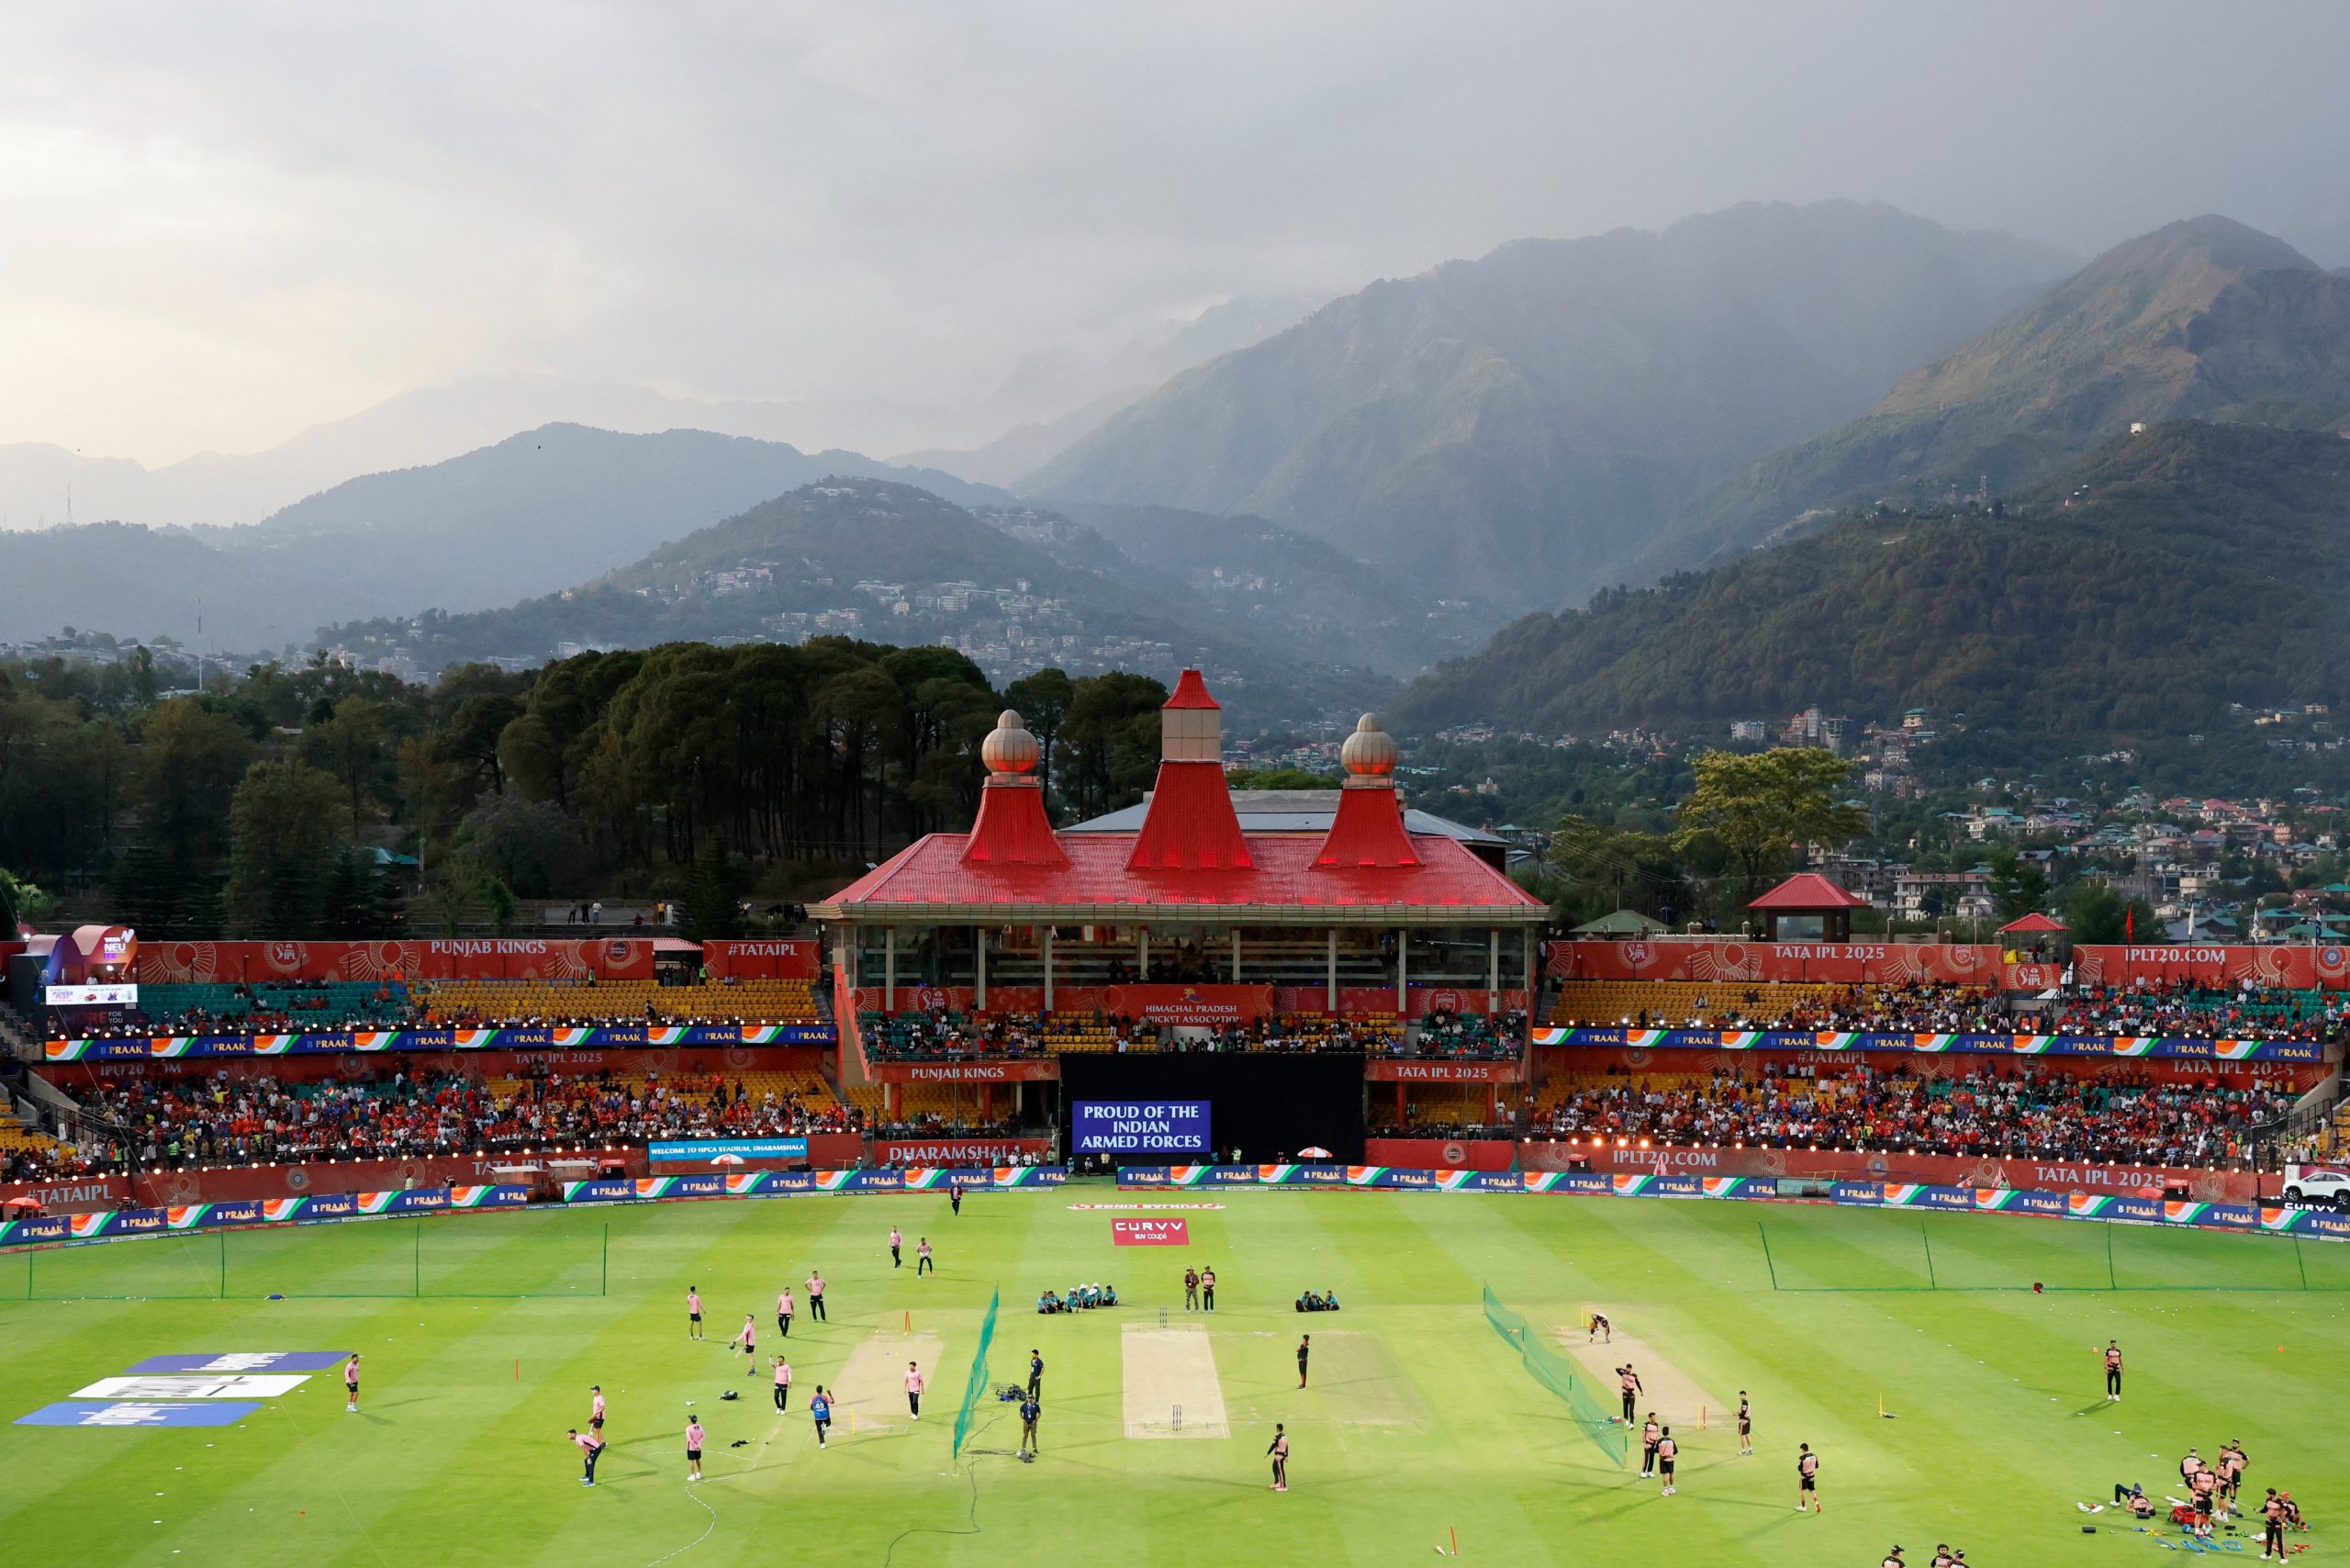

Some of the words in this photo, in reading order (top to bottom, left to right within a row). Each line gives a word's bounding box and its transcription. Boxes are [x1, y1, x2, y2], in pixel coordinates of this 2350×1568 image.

[104, 943, 126, 952] NEU
[431, 941, 492, 957] PUNJAB
[497, 941, 547, 954] KINGS
[728, 944, 798, 957] #TATAIPL
[1774, 946, 1811, 958] TATA
[1816, 946, 1840, 958] IPL
[1844, 946, 1885, 959] 2025
[2125, 948, 2225, 962] IPLT20.COM
[2028, 977, 2042, 986] IPL
[1147, 1015, 1181, 1024] RICKET
[514, 1034, 546, 1043] PRAAK
[610, 1033, 641, 1042] PRAAK
[705, 1032, 735, 1040] PRAAK
[799, 1031, 829, 1040] PRAAK
[1589, 1034, 1619, 1043] PRAAK
[1683, 1036, 1714, 1045] PRAAK
[316, 1039, 349, 1047] PRAAK
[415, 1036, 447, 1046] PRAAK
[1779, 1036, 1810, 1046] PRAAK
[1874, 1038, 1907, 1047] PRAAK
[1974, 1040, 2006, 1049] PRAAK
[109, 1045, 143, 1055] PRAAK
[213, 1042, 246, 1051] PRAAK
[2072, 1042, 2106, 1051] PRAAK
[2175, 1045, 2209, 1054] PRAAK
[2277, 1048, 2311, 1058] PRAAK
[514, 1053, 544, 1064] TATA
[549, 1053, 567, 1063] IPL
[571, 1053, 603, 1063] 2025
[2172, 1059, 2213, 1073] TATA
[2218, 1060, 2244, 1074] IPL
[911, 1068, 961, 1081] PUNJAB
[964, 1068, 1004, 1079] KINGS
[1396, 1067, 1428, 1079] TATA
[1431, 1068, 1451, 1079] IPL
[1455, 1068, 1489, 1079] 2025
[1084, 1106, 1139, 1118] PROUD
[1144, 1106, 1165, 1118] OF
[1169, 1106, 1199, 1118] THE
[1113, 1121, 1169, 1133] INDIAN
[1081, 1136, 1138, 1148] ARMED
[1143, 1136, 1202, 1148] FORCES
[719, 1145, 752, 1153] STADIUM,
[754, 1144, 804, 1152] DHARAMSHALA
[1613, 1150, 1717, 1166] IPLT20.COM
[951, 1175, 957, 1183] B
[958, 1175, 988, 1183] PRAAK
[1135, 1172, 1164, 1182] PRAAK
[1223, 1171, 1252, 1181] PRAAK
[1311, 1170, 1340, 1180] PRAAK
[1393, 1174, 1398, 1182] B
[1400, 1174, 1428, 1183] PRAAK
[2035, 1166, 2079, 1183] TATA
[2085, 1170, 2112, 1185] IPL
[2119, 1170, 2165, 1189] 2025
[772, 1180, 778, 1188] B
[780, 1179, 809, 1188] PRAAK
[862, 1177, 867, 1185] B
[869, 1176, 898, 1185] PRAAK
[1481, 1178, 1487, 1186] B
[1489, 1178, 1517, 1187] PRAAK
[1570, 1180, 1576, 1188] B
[1577, 1180, 1606, 1189] PRAAK
[592, 1188, 598, 1196] B
[599, 1187, 629, 1196] PRAAK
[682, 1183, 688, 1192] B
[690, 1182, 719, 1192] PRAAK
[1659, 1182, 1665, 1191] B
[1667, 1182, 1695, 1192] PRAAK
[1756, 1185, 1775, 1194] PRA
[26, 1184, 113, 1205] #TATAIPL
[499, 1193, 506, 1201] B
[507, 1192, 527, 1201] PRA
[1840, 1189, 1845, 1197] B
[1847, 1189, 1876, 1199] PRAAK
[1930, 1193, 1937, 1202] B
[1939, 1193, 1969, 1204] PRAAK
[406, 1197, 412, 1205] B
[414, 1195, 444, 1205] PRAAK
[2023, 1198, 2030, 1206] B
[2031, 1198, 2062, 1209] PRAAK
[312, 1204, 319, 1213] B
[319, 1202, 351, 1213] PRAAK
[2118, 1204, 2124, 1214] B
[2126, 1205, 2157, 1216] PRAAK
[2284, 1202, 2337, 1213] CURVV
[217, 1212, 223, 1220] B
[225, 1209, 256, 1220] PRAAK
[2214, 1212, 2220, 1221] B
[2222, 1213, 2254, 1224] PRAAK
[120, 1219, 128, 1228] B
[129, 1216, 161, 1228] PRAAK
[1115, 1222, 1183, 1231] CURVV
[2311, 1219, 2317, 1227] B
[2320, 1220, 2350, 1231] PRAAK
[22, 1228, 28, 1237] B
[30, 1225, 63, 1237] PRAAK
[1147, 1232, 1168, 1241] coupé
